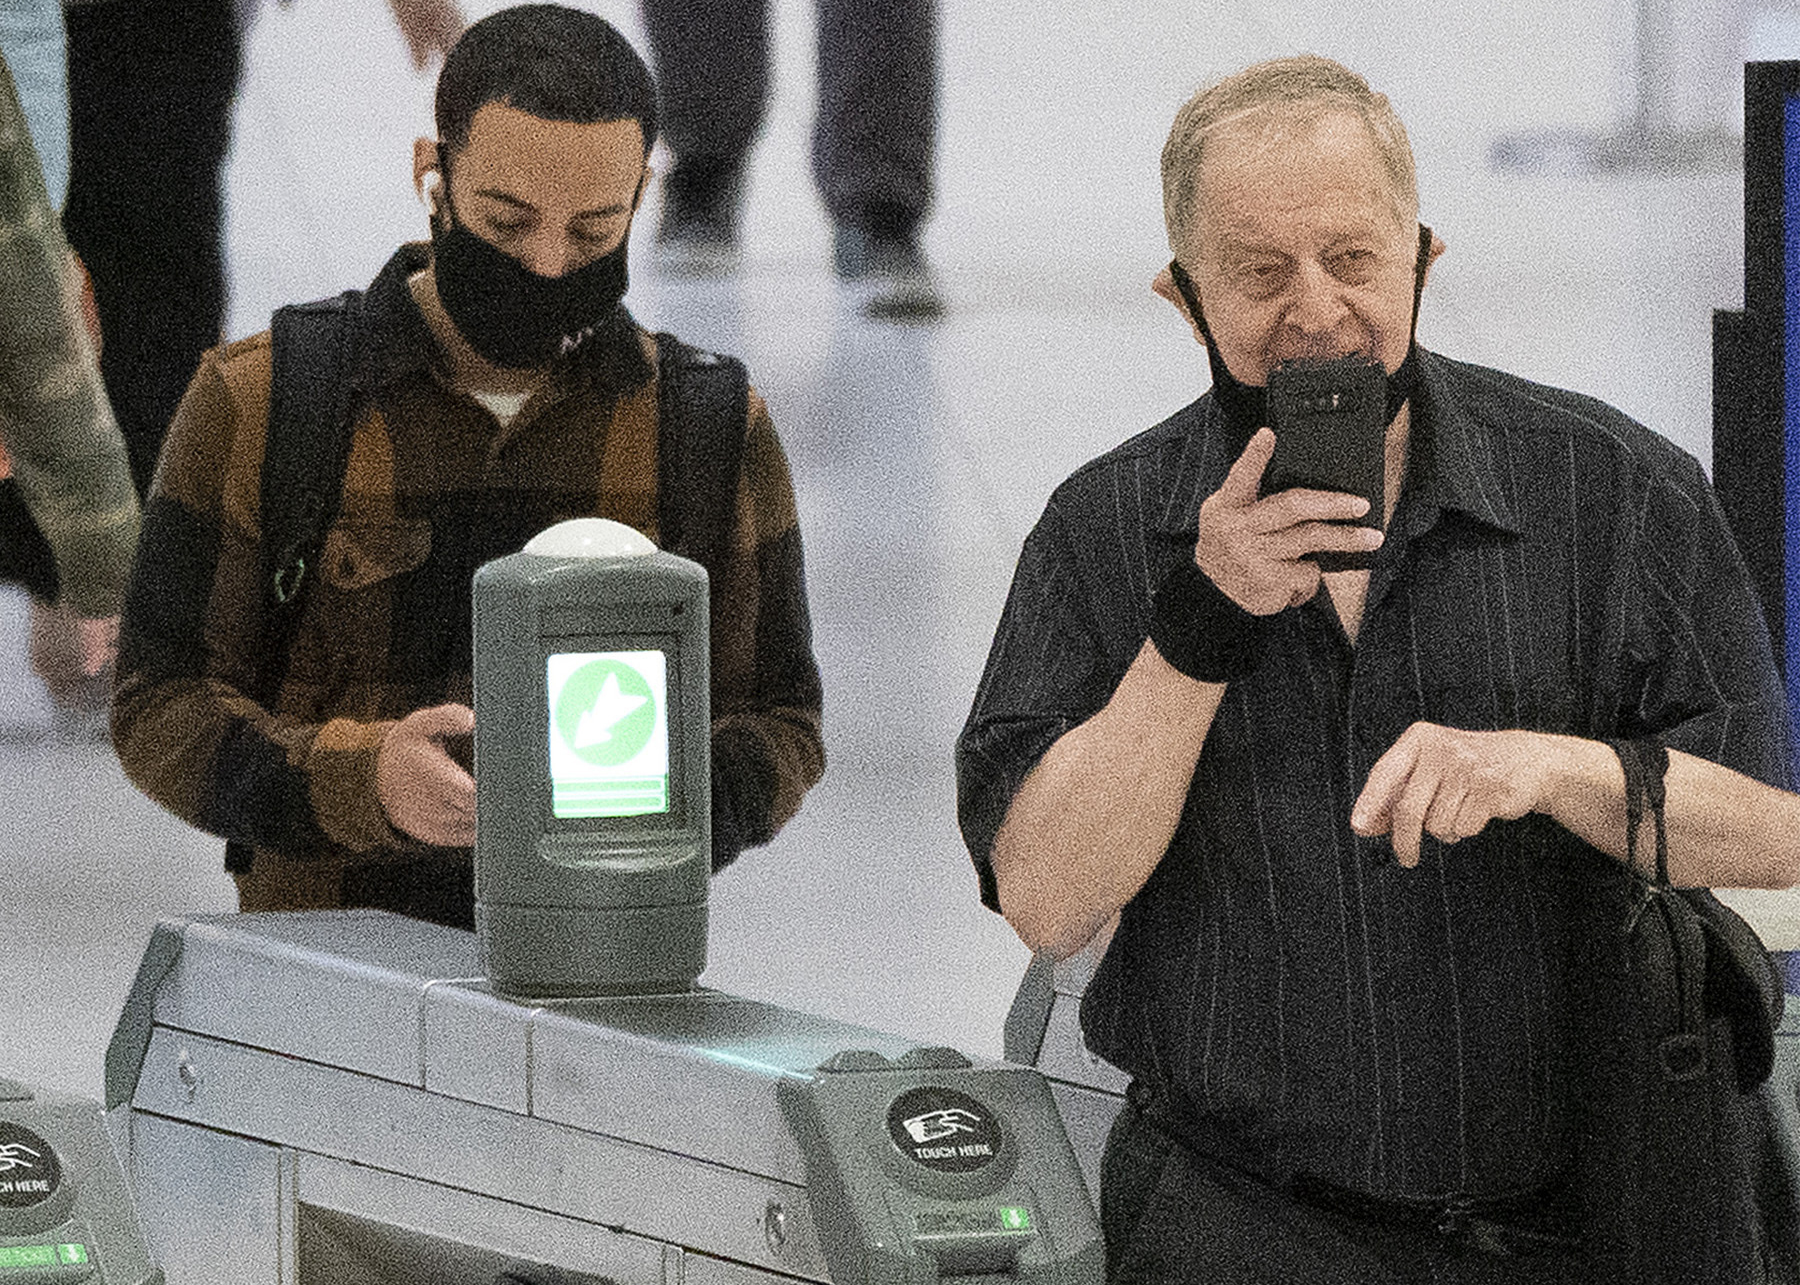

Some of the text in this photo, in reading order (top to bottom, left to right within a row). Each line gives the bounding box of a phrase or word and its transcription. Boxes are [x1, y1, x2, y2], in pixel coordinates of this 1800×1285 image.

[915, 1144, 993, 1159] TOUCH HERE
[16, 1180, 50, 1193] HERE
